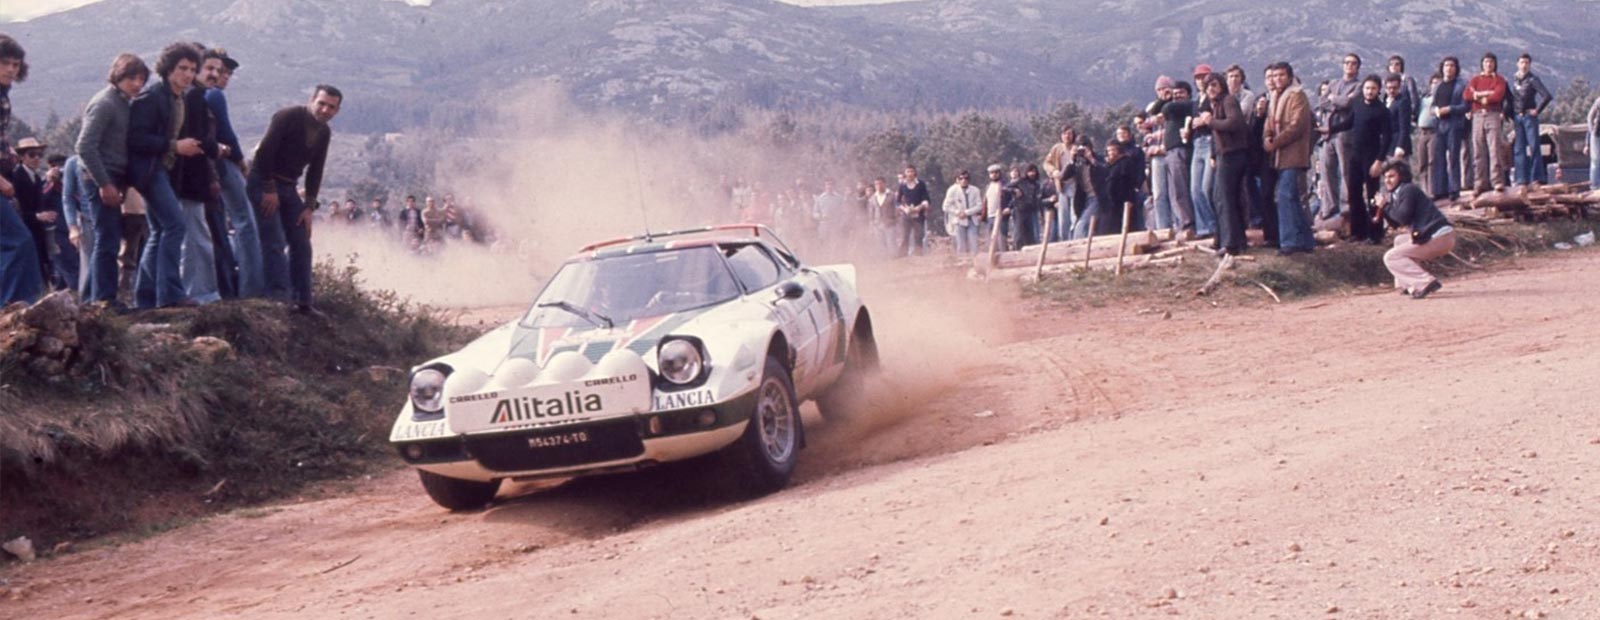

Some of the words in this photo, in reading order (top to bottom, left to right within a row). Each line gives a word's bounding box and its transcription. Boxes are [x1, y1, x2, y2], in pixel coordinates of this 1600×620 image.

[584, 374, 637, 387] CARELLO
[449, 391, 498, 403] CARELLO
[654, 389, 715, 411] LANCIA
[490, 390, 602, 424] Alitalia
